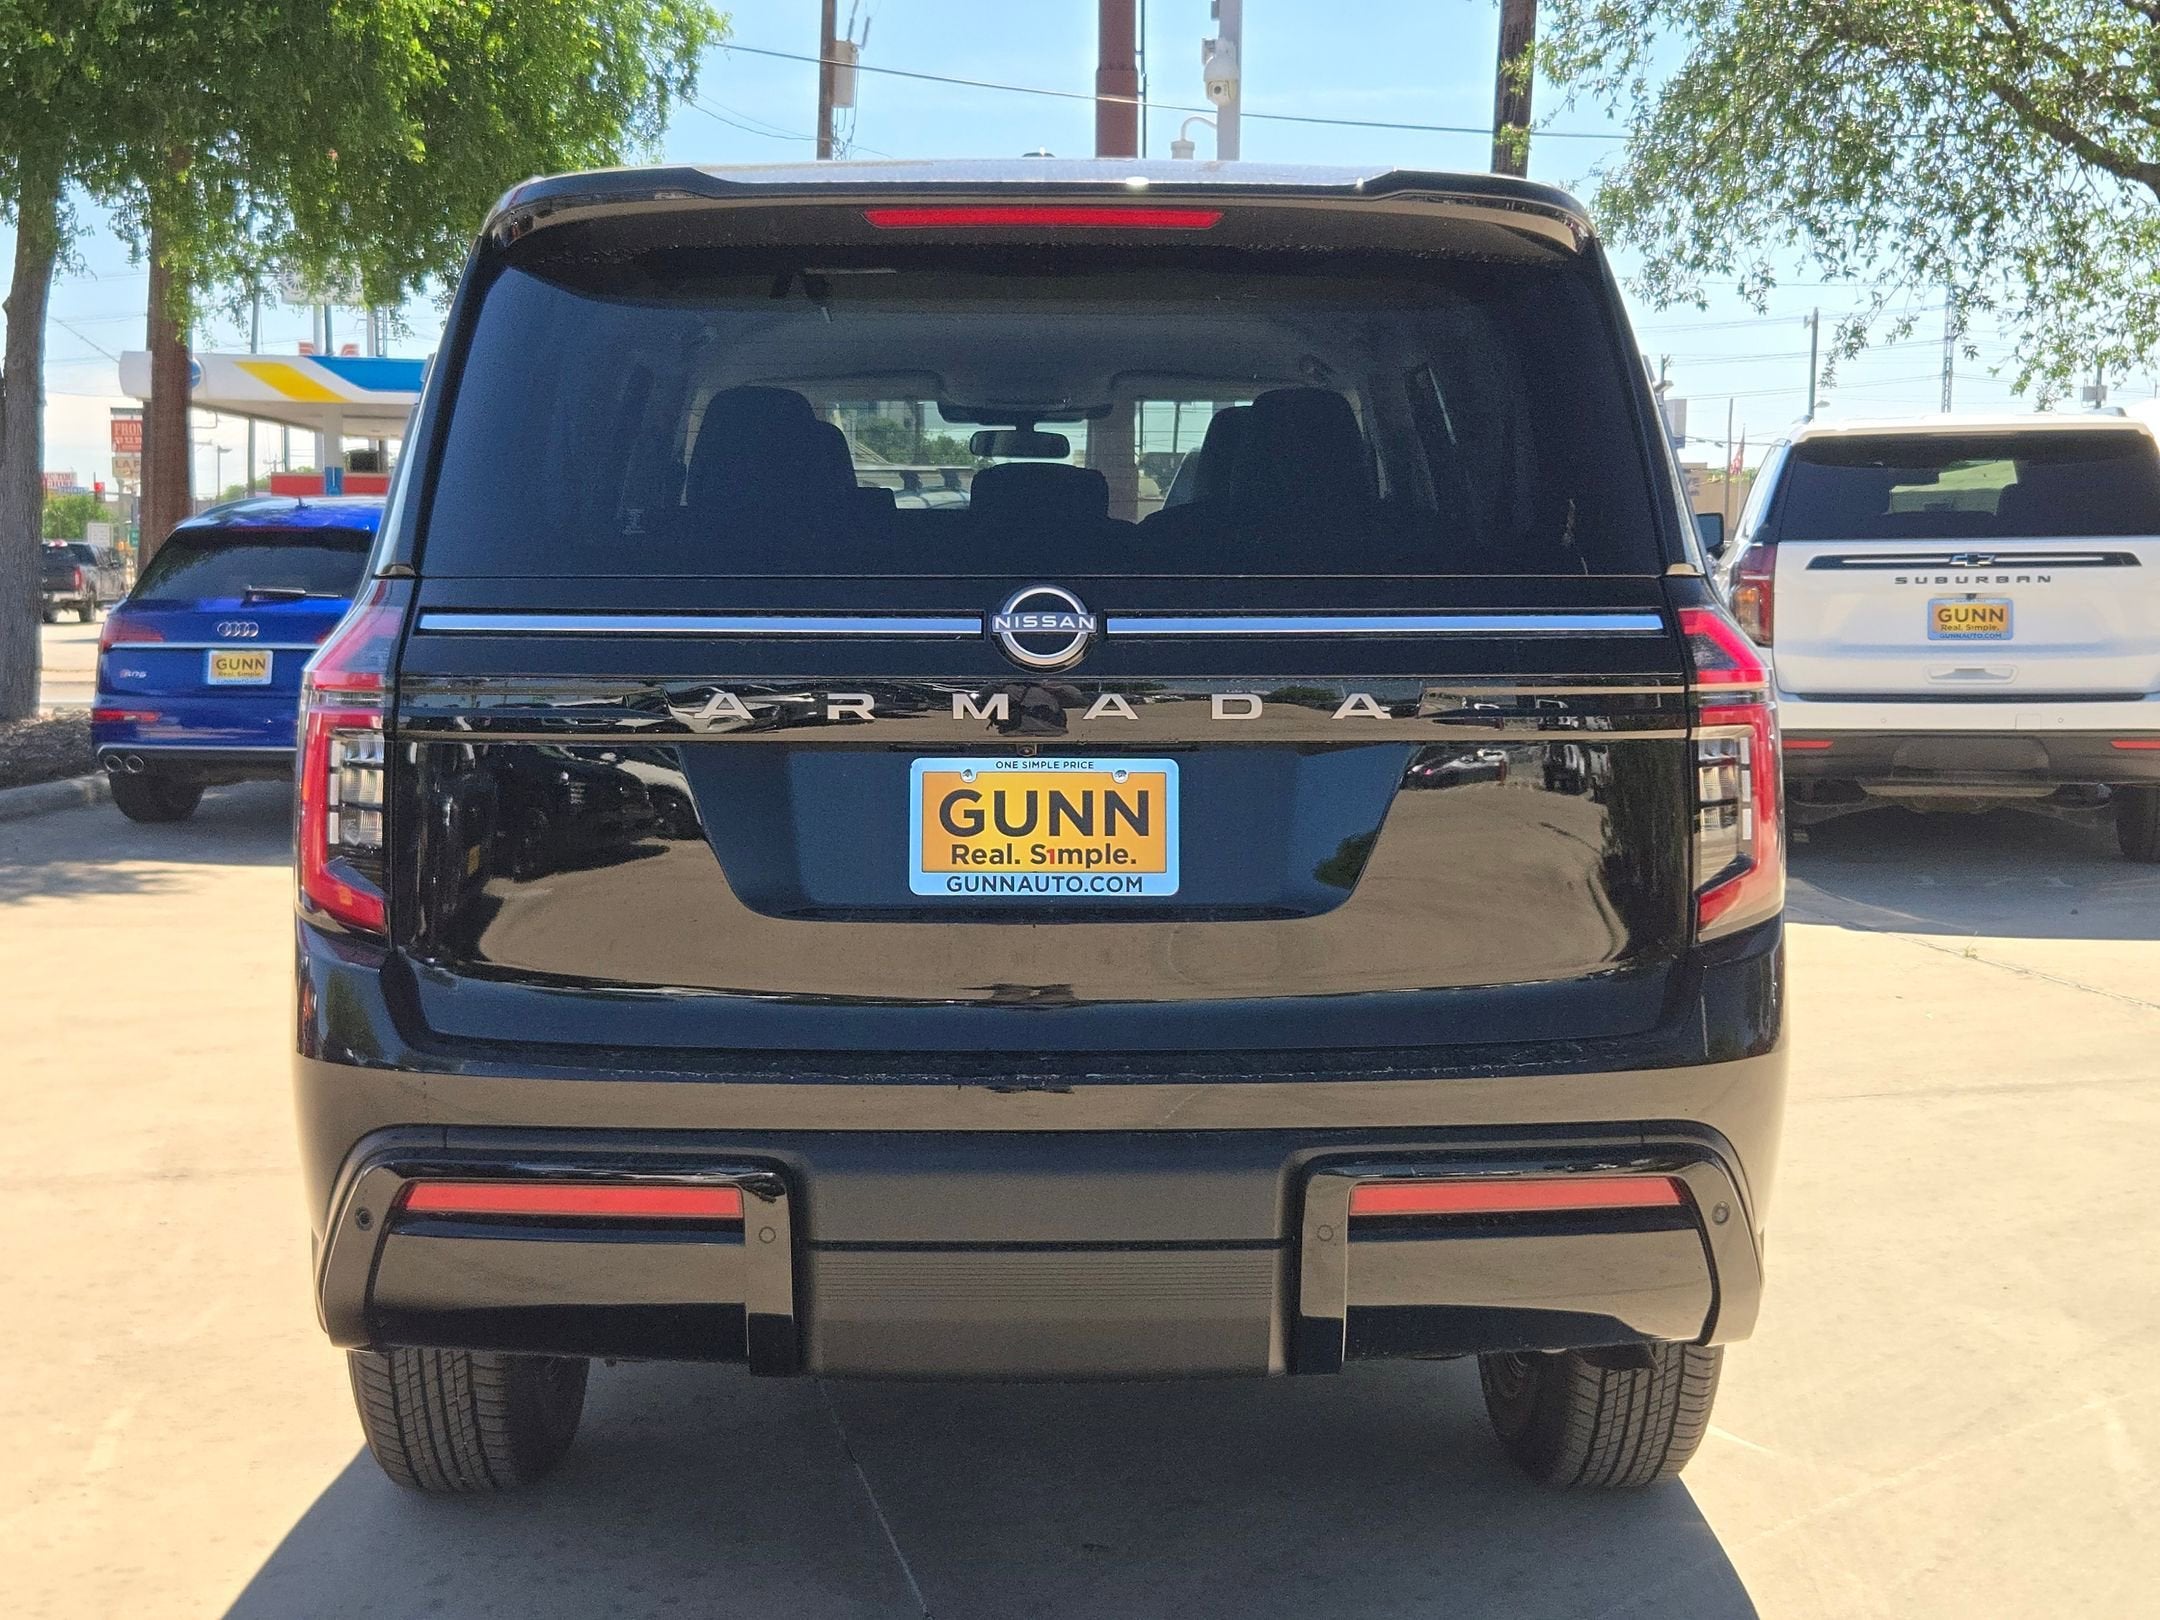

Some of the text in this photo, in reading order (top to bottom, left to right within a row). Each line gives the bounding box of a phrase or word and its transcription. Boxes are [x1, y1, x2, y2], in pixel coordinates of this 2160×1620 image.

[1894, 575, 2052, 585] SUBURBAN
[994, 614, 1095, 630] NISSAN
[1937, 607, 2004, 623] GUNN
[216, 658, 266, 671] GUNN
[700, 692, 1393, 721] ARMADA
[995, 760, 1094, 769] ONE SIMPLE PRICE
[938, 788, 1150, 838] GUNN
[951, 843, 1021, 865] Real.
[946, 875, 1143, 893] GUNNAUTO.COM
